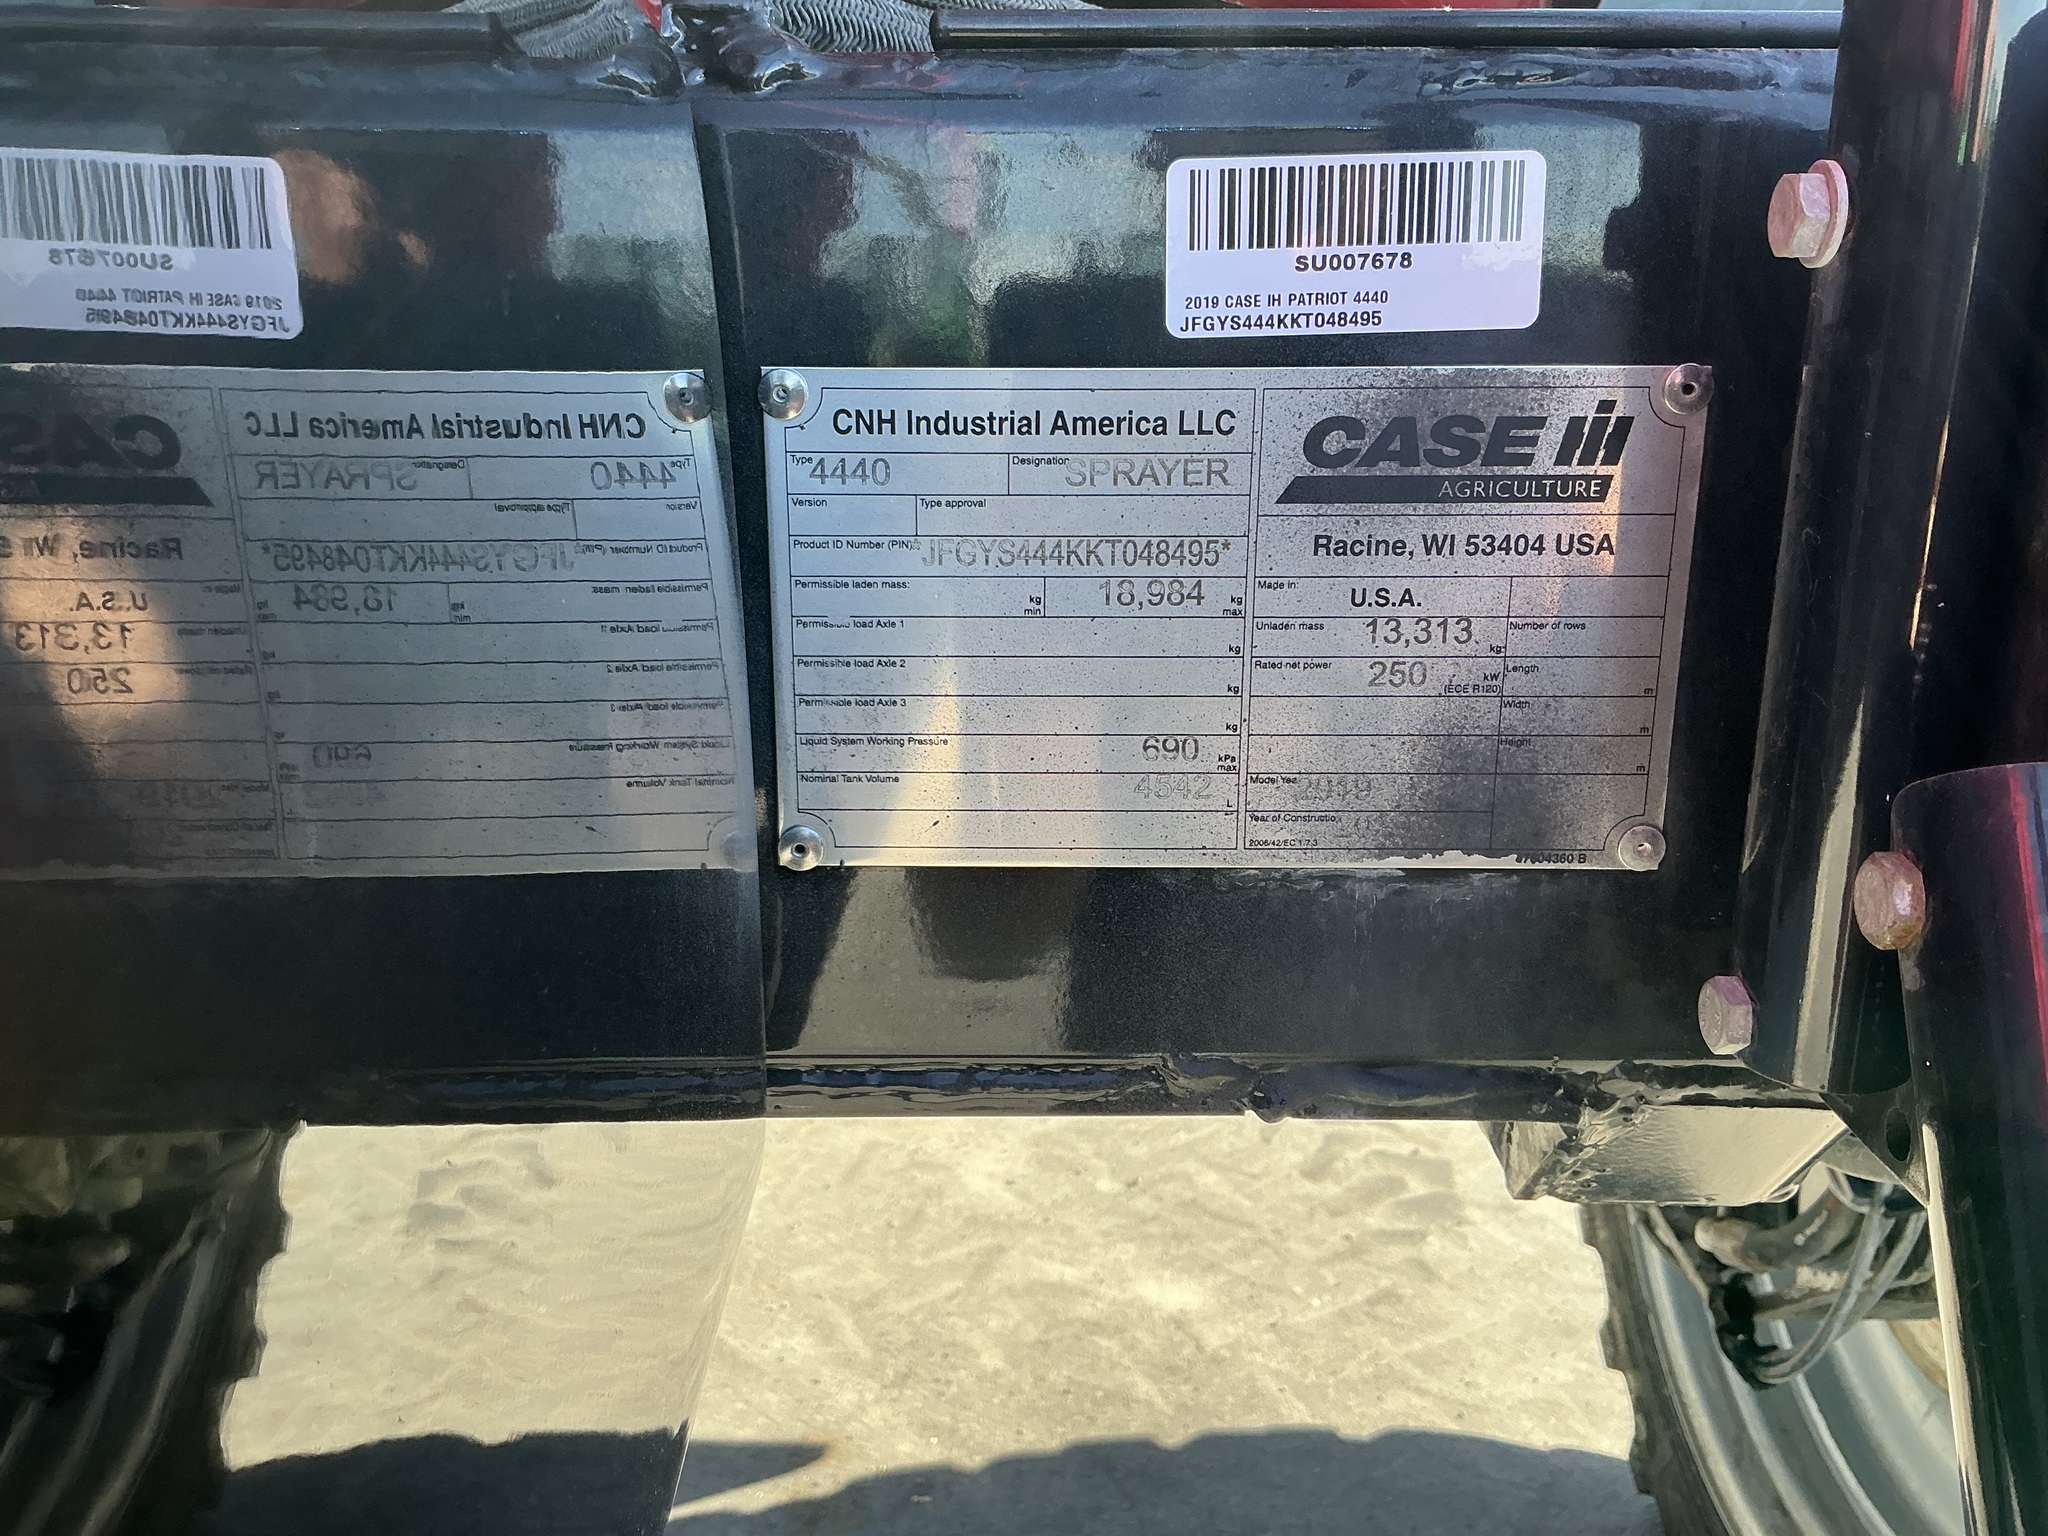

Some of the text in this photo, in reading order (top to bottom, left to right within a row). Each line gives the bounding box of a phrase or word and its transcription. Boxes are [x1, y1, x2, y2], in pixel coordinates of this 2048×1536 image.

[1295, 252, 1413, 272] SU007678
[1185, 291, 1388, 310] 2019 CASE IH PATRIOT 4440
[1179, 311, 1382, 333] JFGYS444KKT048495
[833, 409, 1236, 436] CNH Industrial America LLC
[1303, 416, 1547, 469] CASE
[791, 455, 813, 466] Type
[809, 458, 891, 485] 4440
[1065, 458, 1230, 487] SPRAYER
[1438, 480, 1601, 498] AGRICULTURE
[792, 498, 828, 507] Version
[920, 499, 987, 510] Type approval
[794, 540, 829, 549] Product
[833, 540, 843, 548] ID
[847, 540, 885, 549] Number
[1313, 534, 1615, 561] Racine, WI 53404 USA
[795, 580, 909, 589] Permissible laden mass:
[1258, 581, 1284, 590] Made
[1030, 594, 1041, 605] kg
[1100, 579, 1205, 609] 18,984
[1231, 594, 1243, 605] kg
[1351, 589, 1421, 607] U.S.A.
[1024, 607, 1042, 616] min
[1222, 607, 1243, 616] max
[853, 620, 873, 628] load
[876, 620, 894, 628] Axle
[900, 620, 904, 628] 1
[1256, 621, 1324, 631] Unladen mass
[1509, 621, 1586, 631] Number of rows
[1365, 618, 1473, 647] 13,313
[1228, 643, 1241, 654] kg
[1490, 644, 1503, 654] kg
[854, 659, 874, 667] load
[877, 659, 897, 667] Axle
[1255, 660, 1332, 672] Rated net power
[1368, 661, 1427, 687] 250
[1506, 664, 1539, 674] Length
[1483, 672, 1500, 682] kW
[1228, 683, 1239, 694] kg
[1444, 684, 1470, 695] (ECE
[1503, 700, 1531, 709] Width
[1226, 722, 1238, 732] kg
[800, 737, 948, 746] Liquid System Working Pressure
[1500, 737, 1532, 748] Height
[1141, 736, 1199, 763] 690
[1218, 754, 1236, 763] kPa
[801, 775, 900, 784] Nominal Tank Volume
[1250, 776, 1278, 785] Model
[1134, 774, 1211, 799] 4542
[1249, 814, 1268, 822] Year
[1272, 814, 1280, 822] of
[1578, 854, 1586, 863] B
